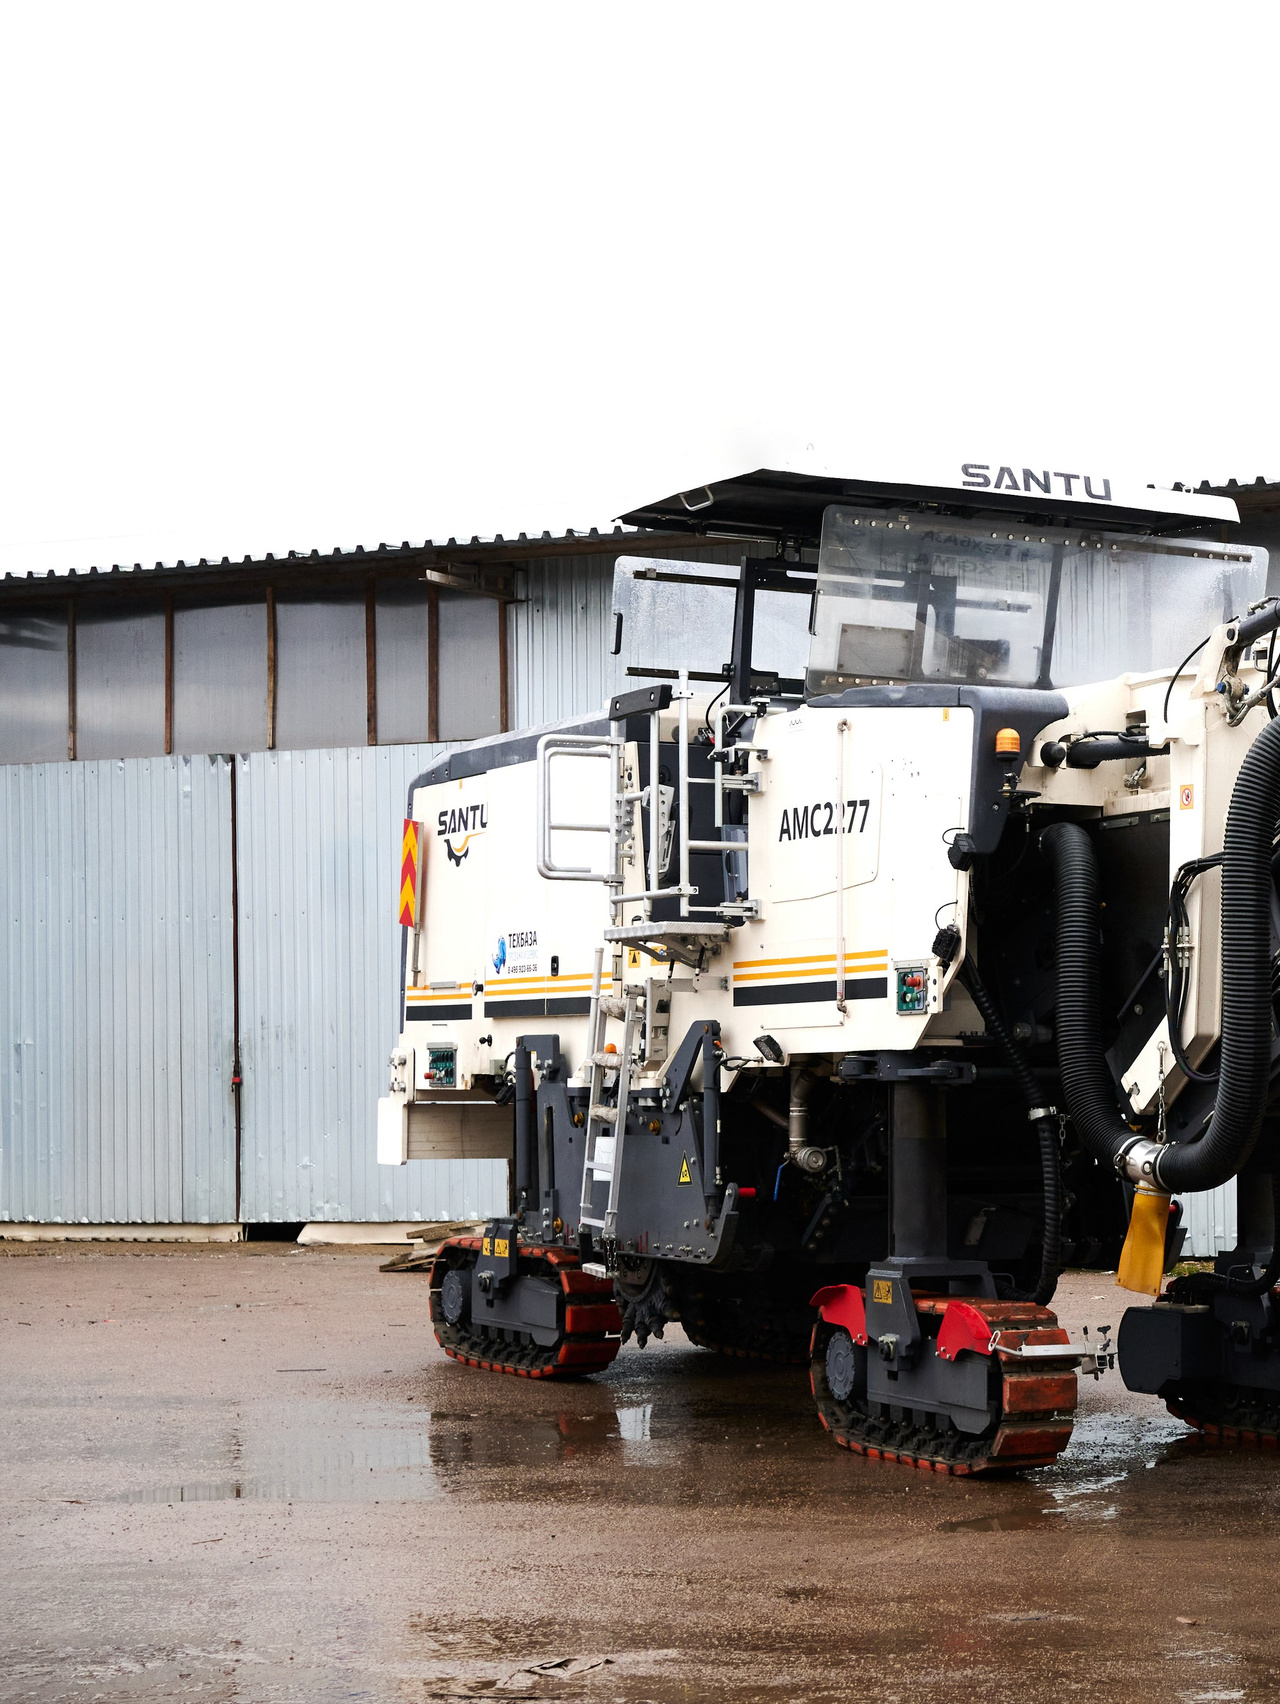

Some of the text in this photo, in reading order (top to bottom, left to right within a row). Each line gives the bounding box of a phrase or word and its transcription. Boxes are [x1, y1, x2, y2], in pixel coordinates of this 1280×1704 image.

[961, 463, 1112, 501] SANTU
[437, 803, 488, 836] SANTU
[508, 930, 538, 948] ТЕХБАЗА
